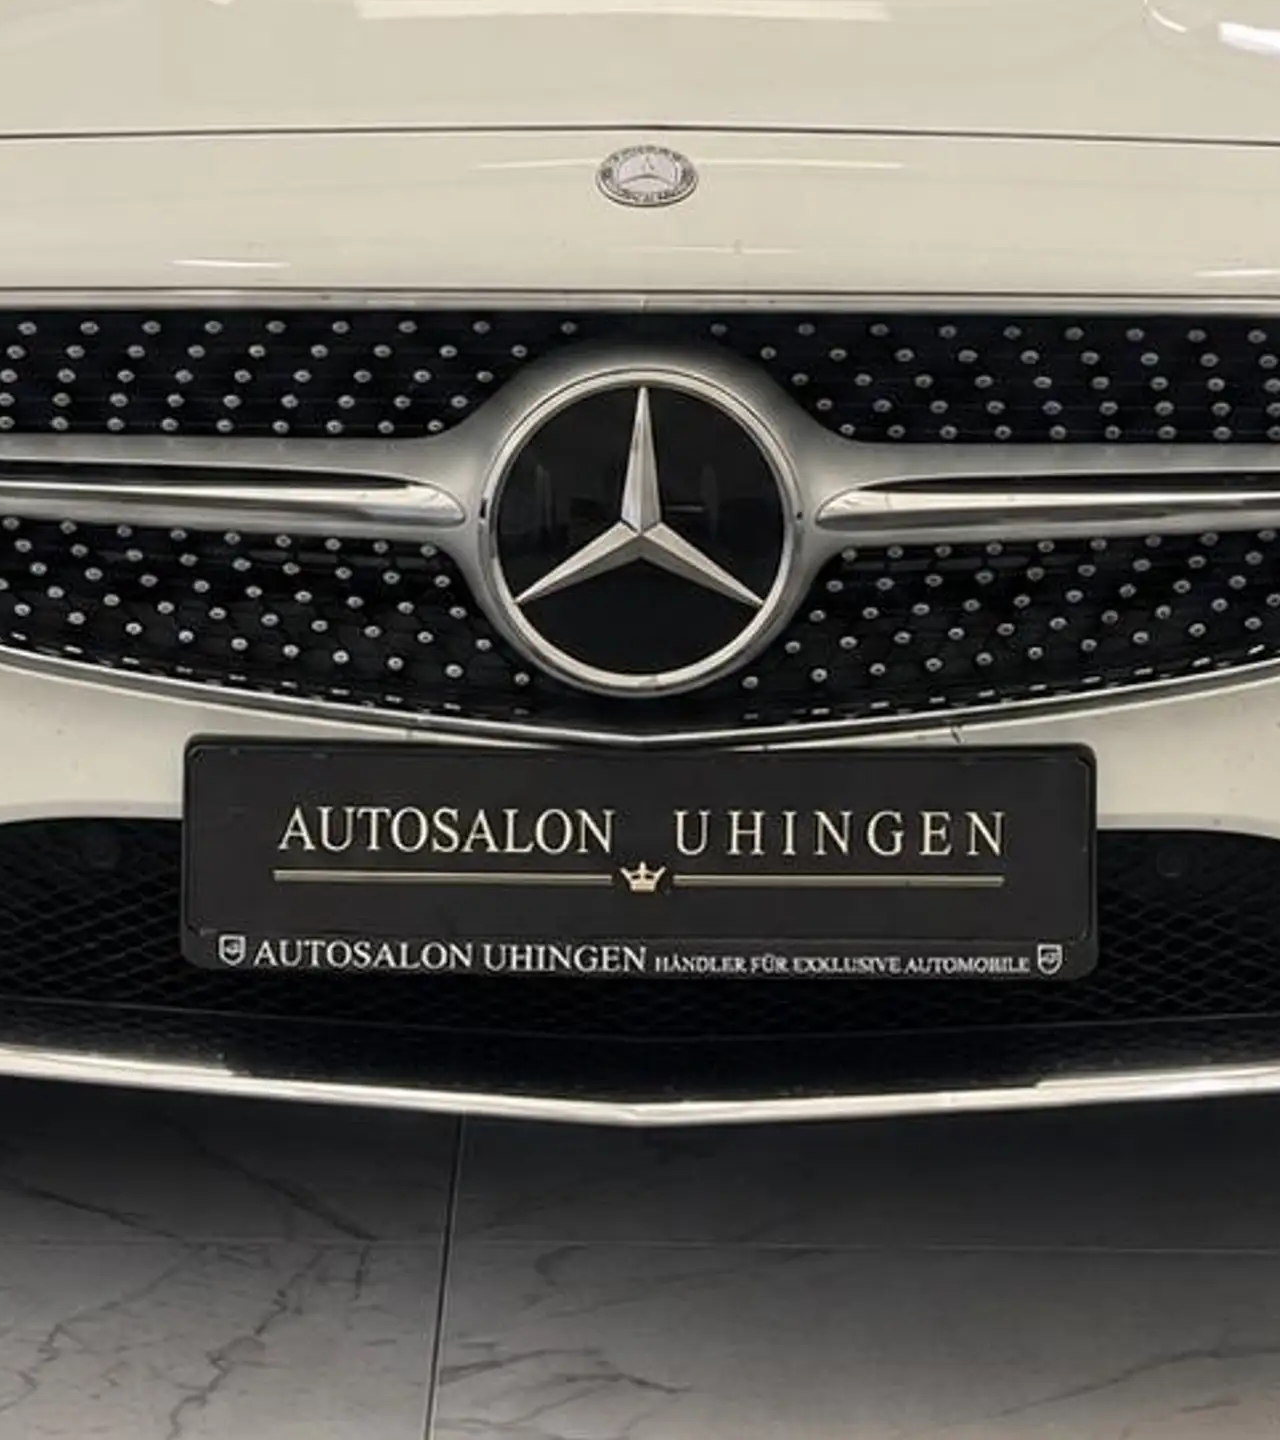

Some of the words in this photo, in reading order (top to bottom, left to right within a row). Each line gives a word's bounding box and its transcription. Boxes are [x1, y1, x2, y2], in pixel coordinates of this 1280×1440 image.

[277, 806, 616, 854] AUTOSALON
[673, 810, 1005, 856] UHINGEN
[253, 940, 472, 969] AUTOSALON
[482, 943, 647, 972] UHINGEN
[655, 954, 747, 973] HÄNDLER
[751, 953, 789, 973] FÜR
[905, 956, 1030, 974] AUTOMOBILE
